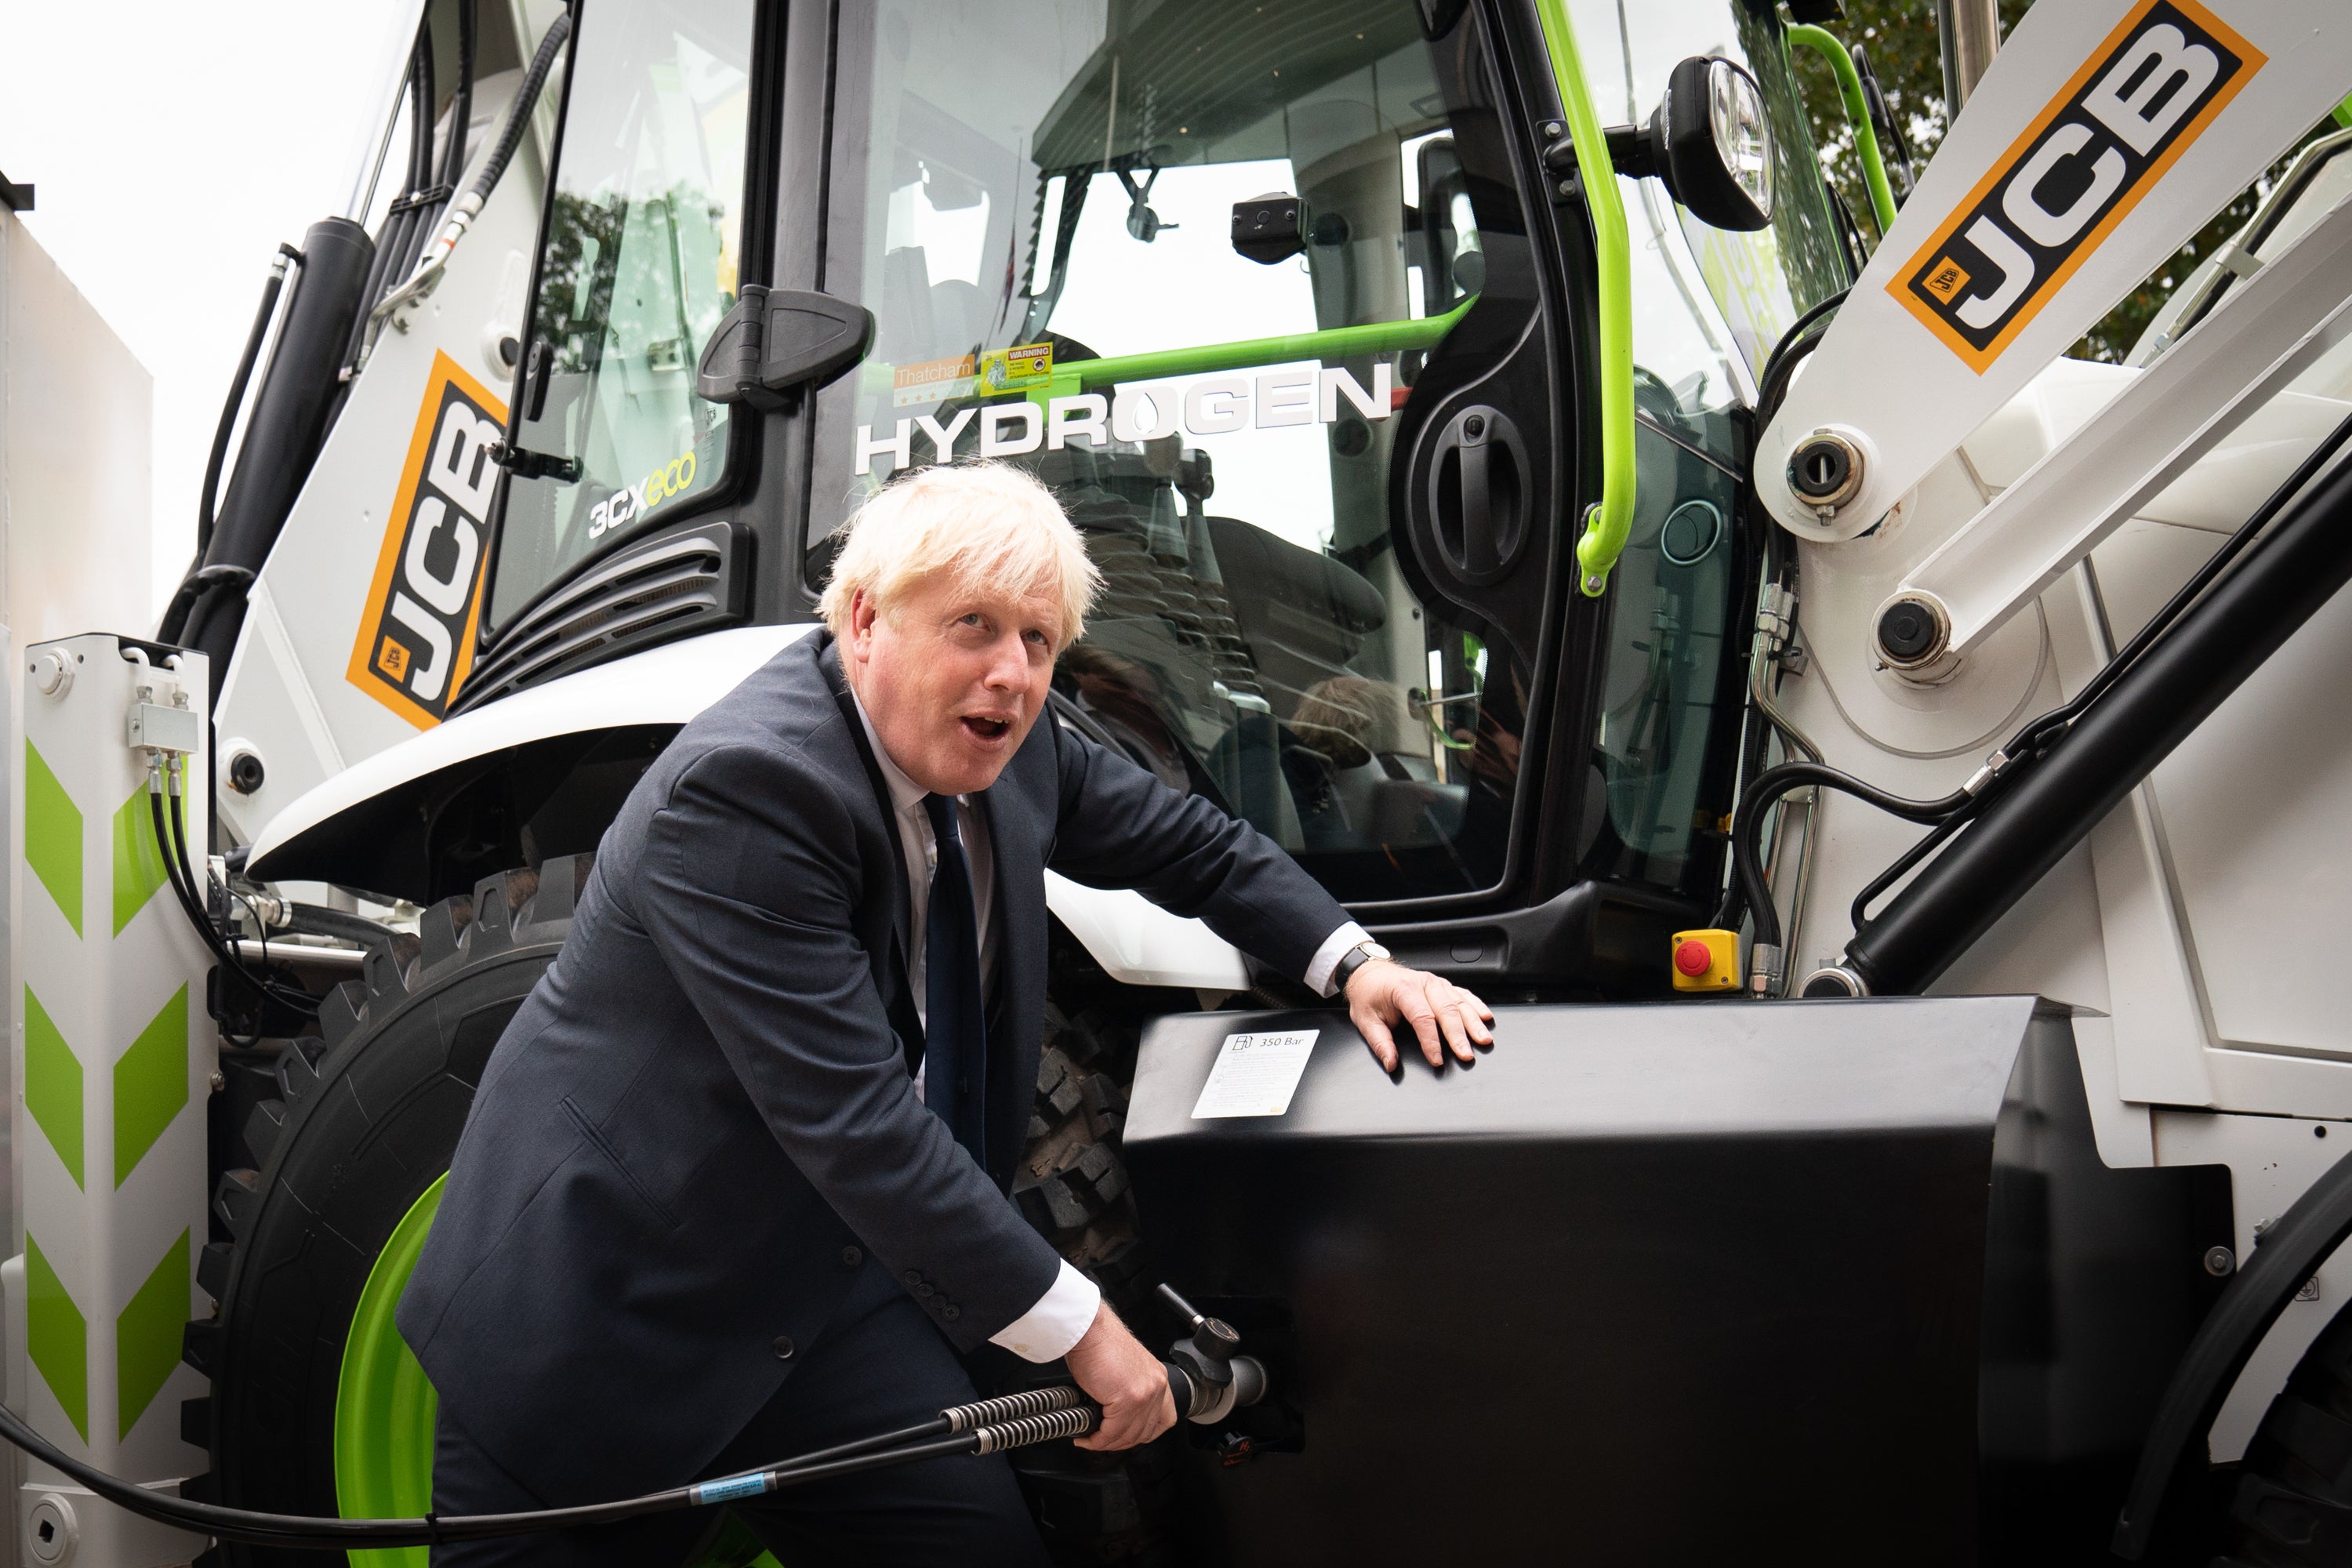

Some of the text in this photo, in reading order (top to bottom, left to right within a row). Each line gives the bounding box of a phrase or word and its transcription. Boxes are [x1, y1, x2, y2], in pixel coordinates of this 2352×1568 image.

[1955, 23, 2220, 329] JCB
[1935, 270, 1957, 290] JCB
[1009, 347, 1049, 360] WARNING
[896, 362, 971, 387] Thatcham
[855, 362, 1392, 476] HYDROGEN
[390, 400, 505, 702] JCB
[387, 648, 400, 668] JCB
[1259, 1036, 1305, 1047] 350 Bar
